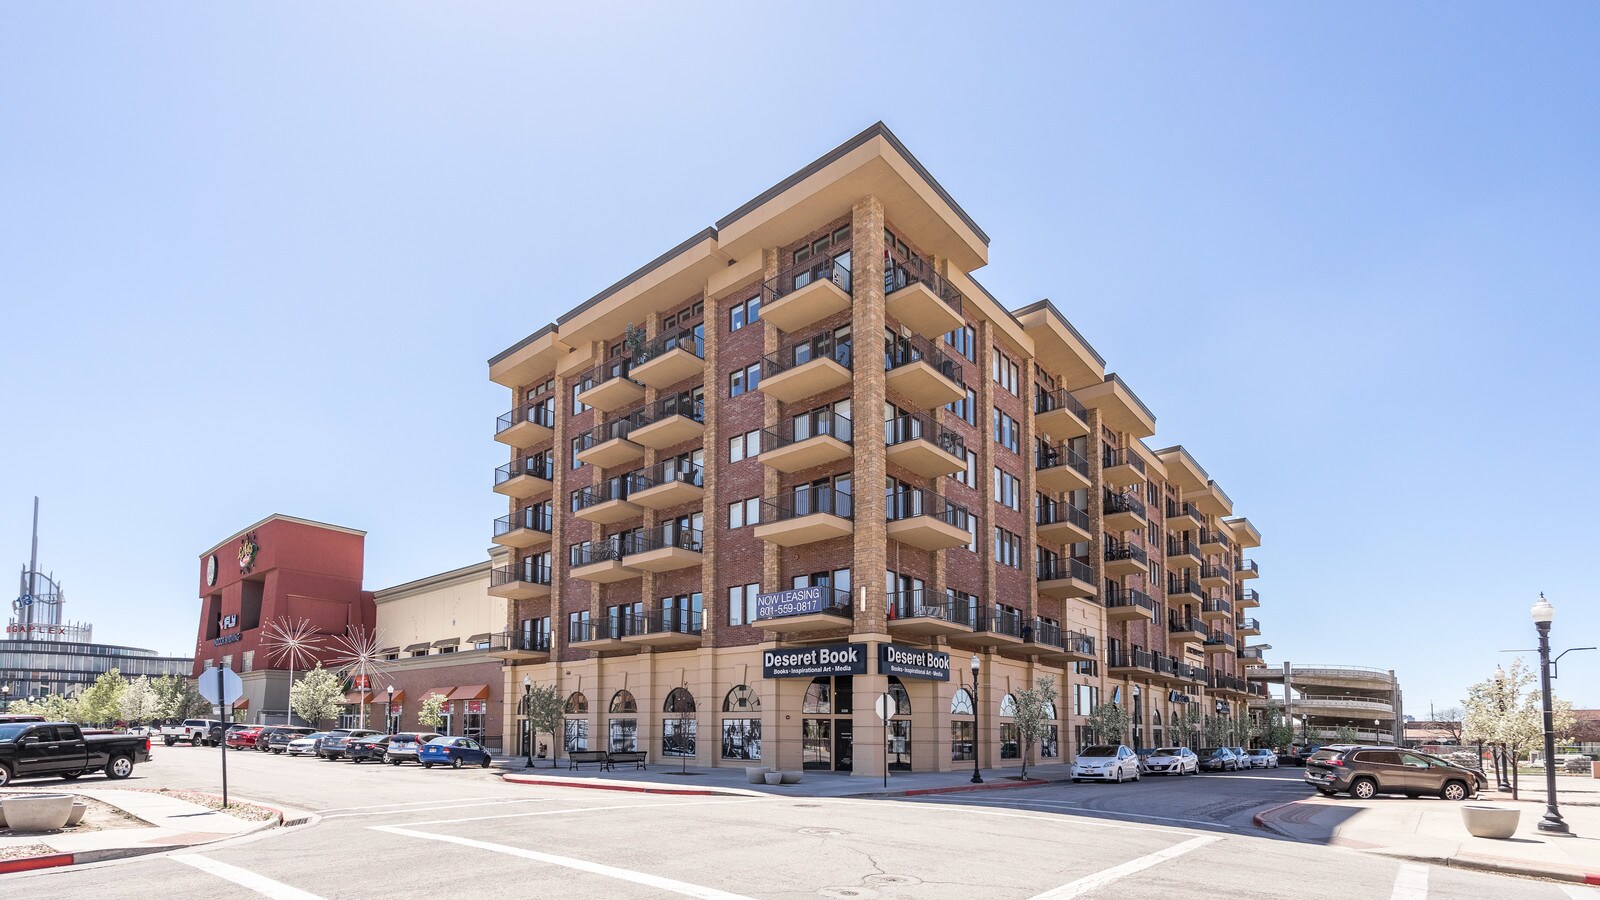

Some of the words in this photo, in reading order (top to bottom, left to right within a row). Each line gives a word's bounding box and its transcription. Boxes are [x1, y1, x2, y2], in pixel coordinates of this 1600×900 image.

[758, 595, 779, 606] NOW
[781, 589, 819, 603] LEASING
[760, 600, 816, 616] 801-559-0817
[765, 650, 817, 667] Deseret
[820, 647, 857, 664] Book
[888, 646, 926, 666] Deseret
[927, 652, 949, 670] Book
